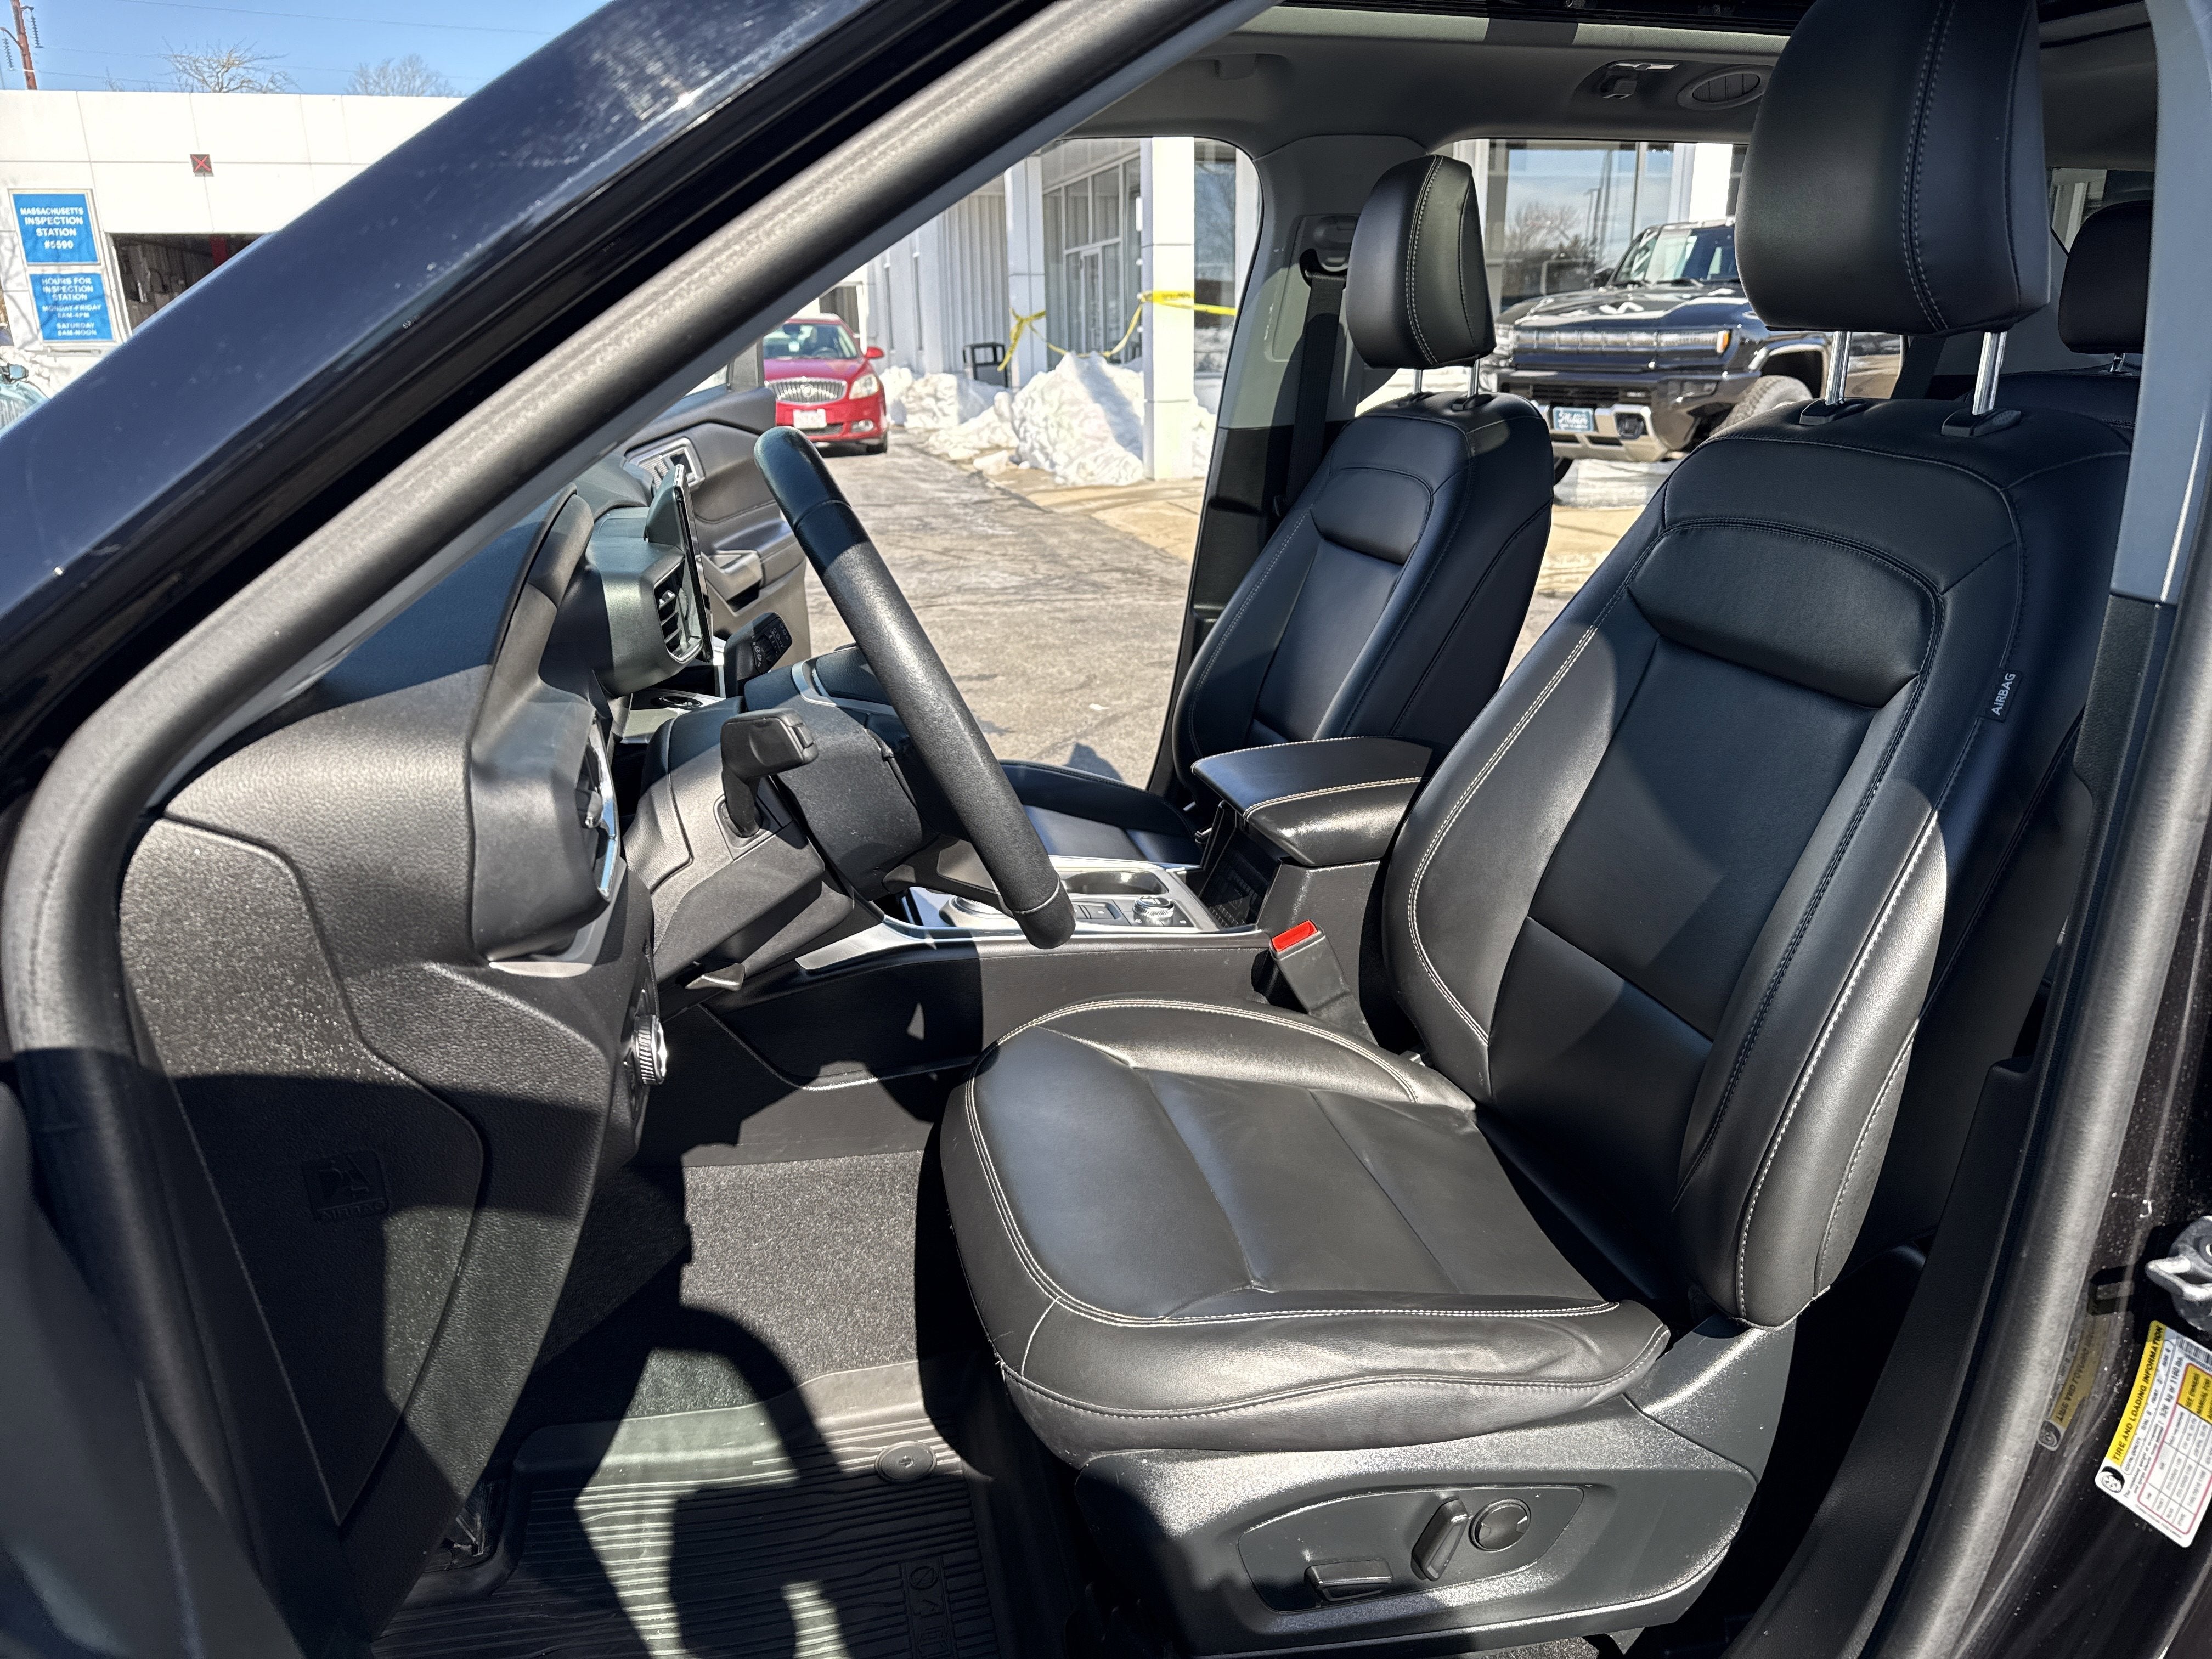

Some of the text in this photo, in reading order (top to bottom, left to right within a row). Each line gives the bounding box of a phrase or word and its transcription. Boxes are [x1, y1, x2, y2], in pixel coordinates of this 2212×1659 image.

[25, 217, 83, 225] INSPECTION
[36, 228, 76, 236] STATION
[1991, 673, 2016, 716] AIRBAG
[2113, 1325, 2163, 1462] TIRE AND LOADING INFORMATION
